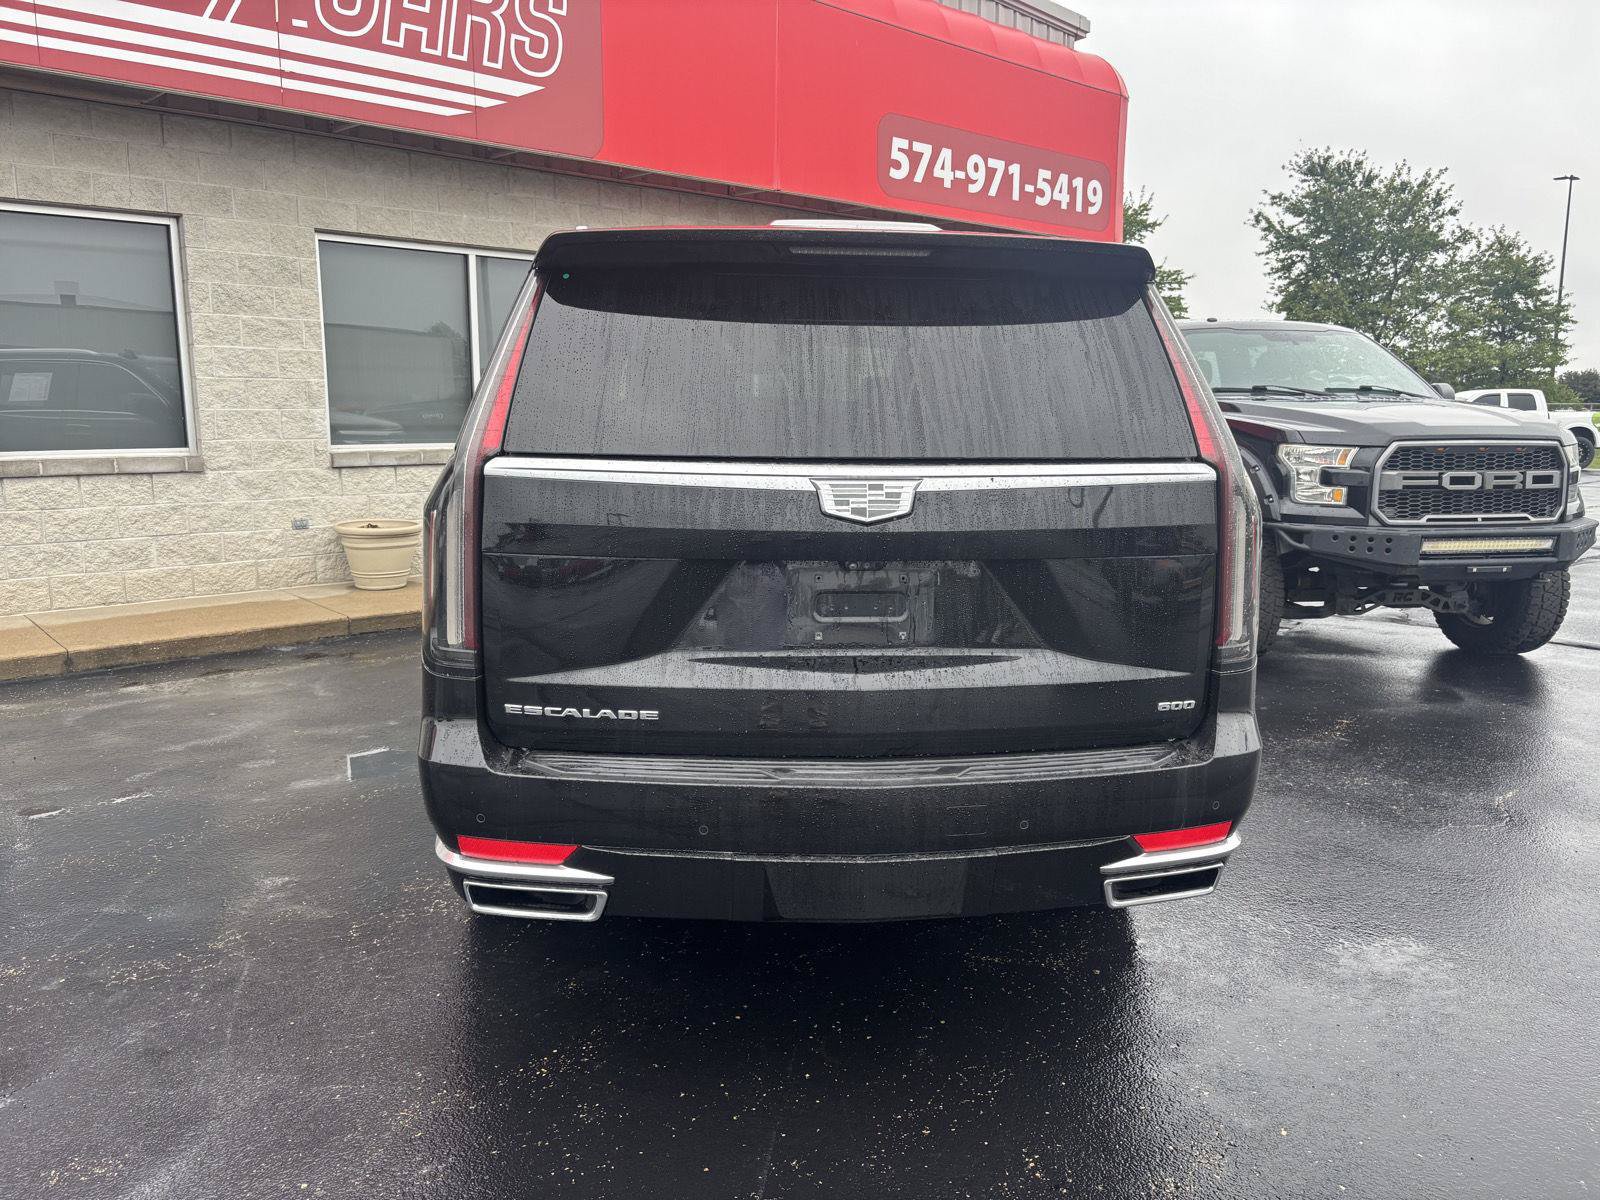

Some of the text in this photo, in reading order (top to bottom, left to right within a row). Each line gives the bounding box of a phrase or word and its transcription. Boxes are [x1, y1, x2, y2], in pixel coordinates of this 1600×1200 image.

[889, 136, 1103, 215] 574-971-5419
[1380, 470, 1561, 490] FORD
[504, 703, 659, 720] ESCALADE
[1157, 700, 1196, 711] 600
